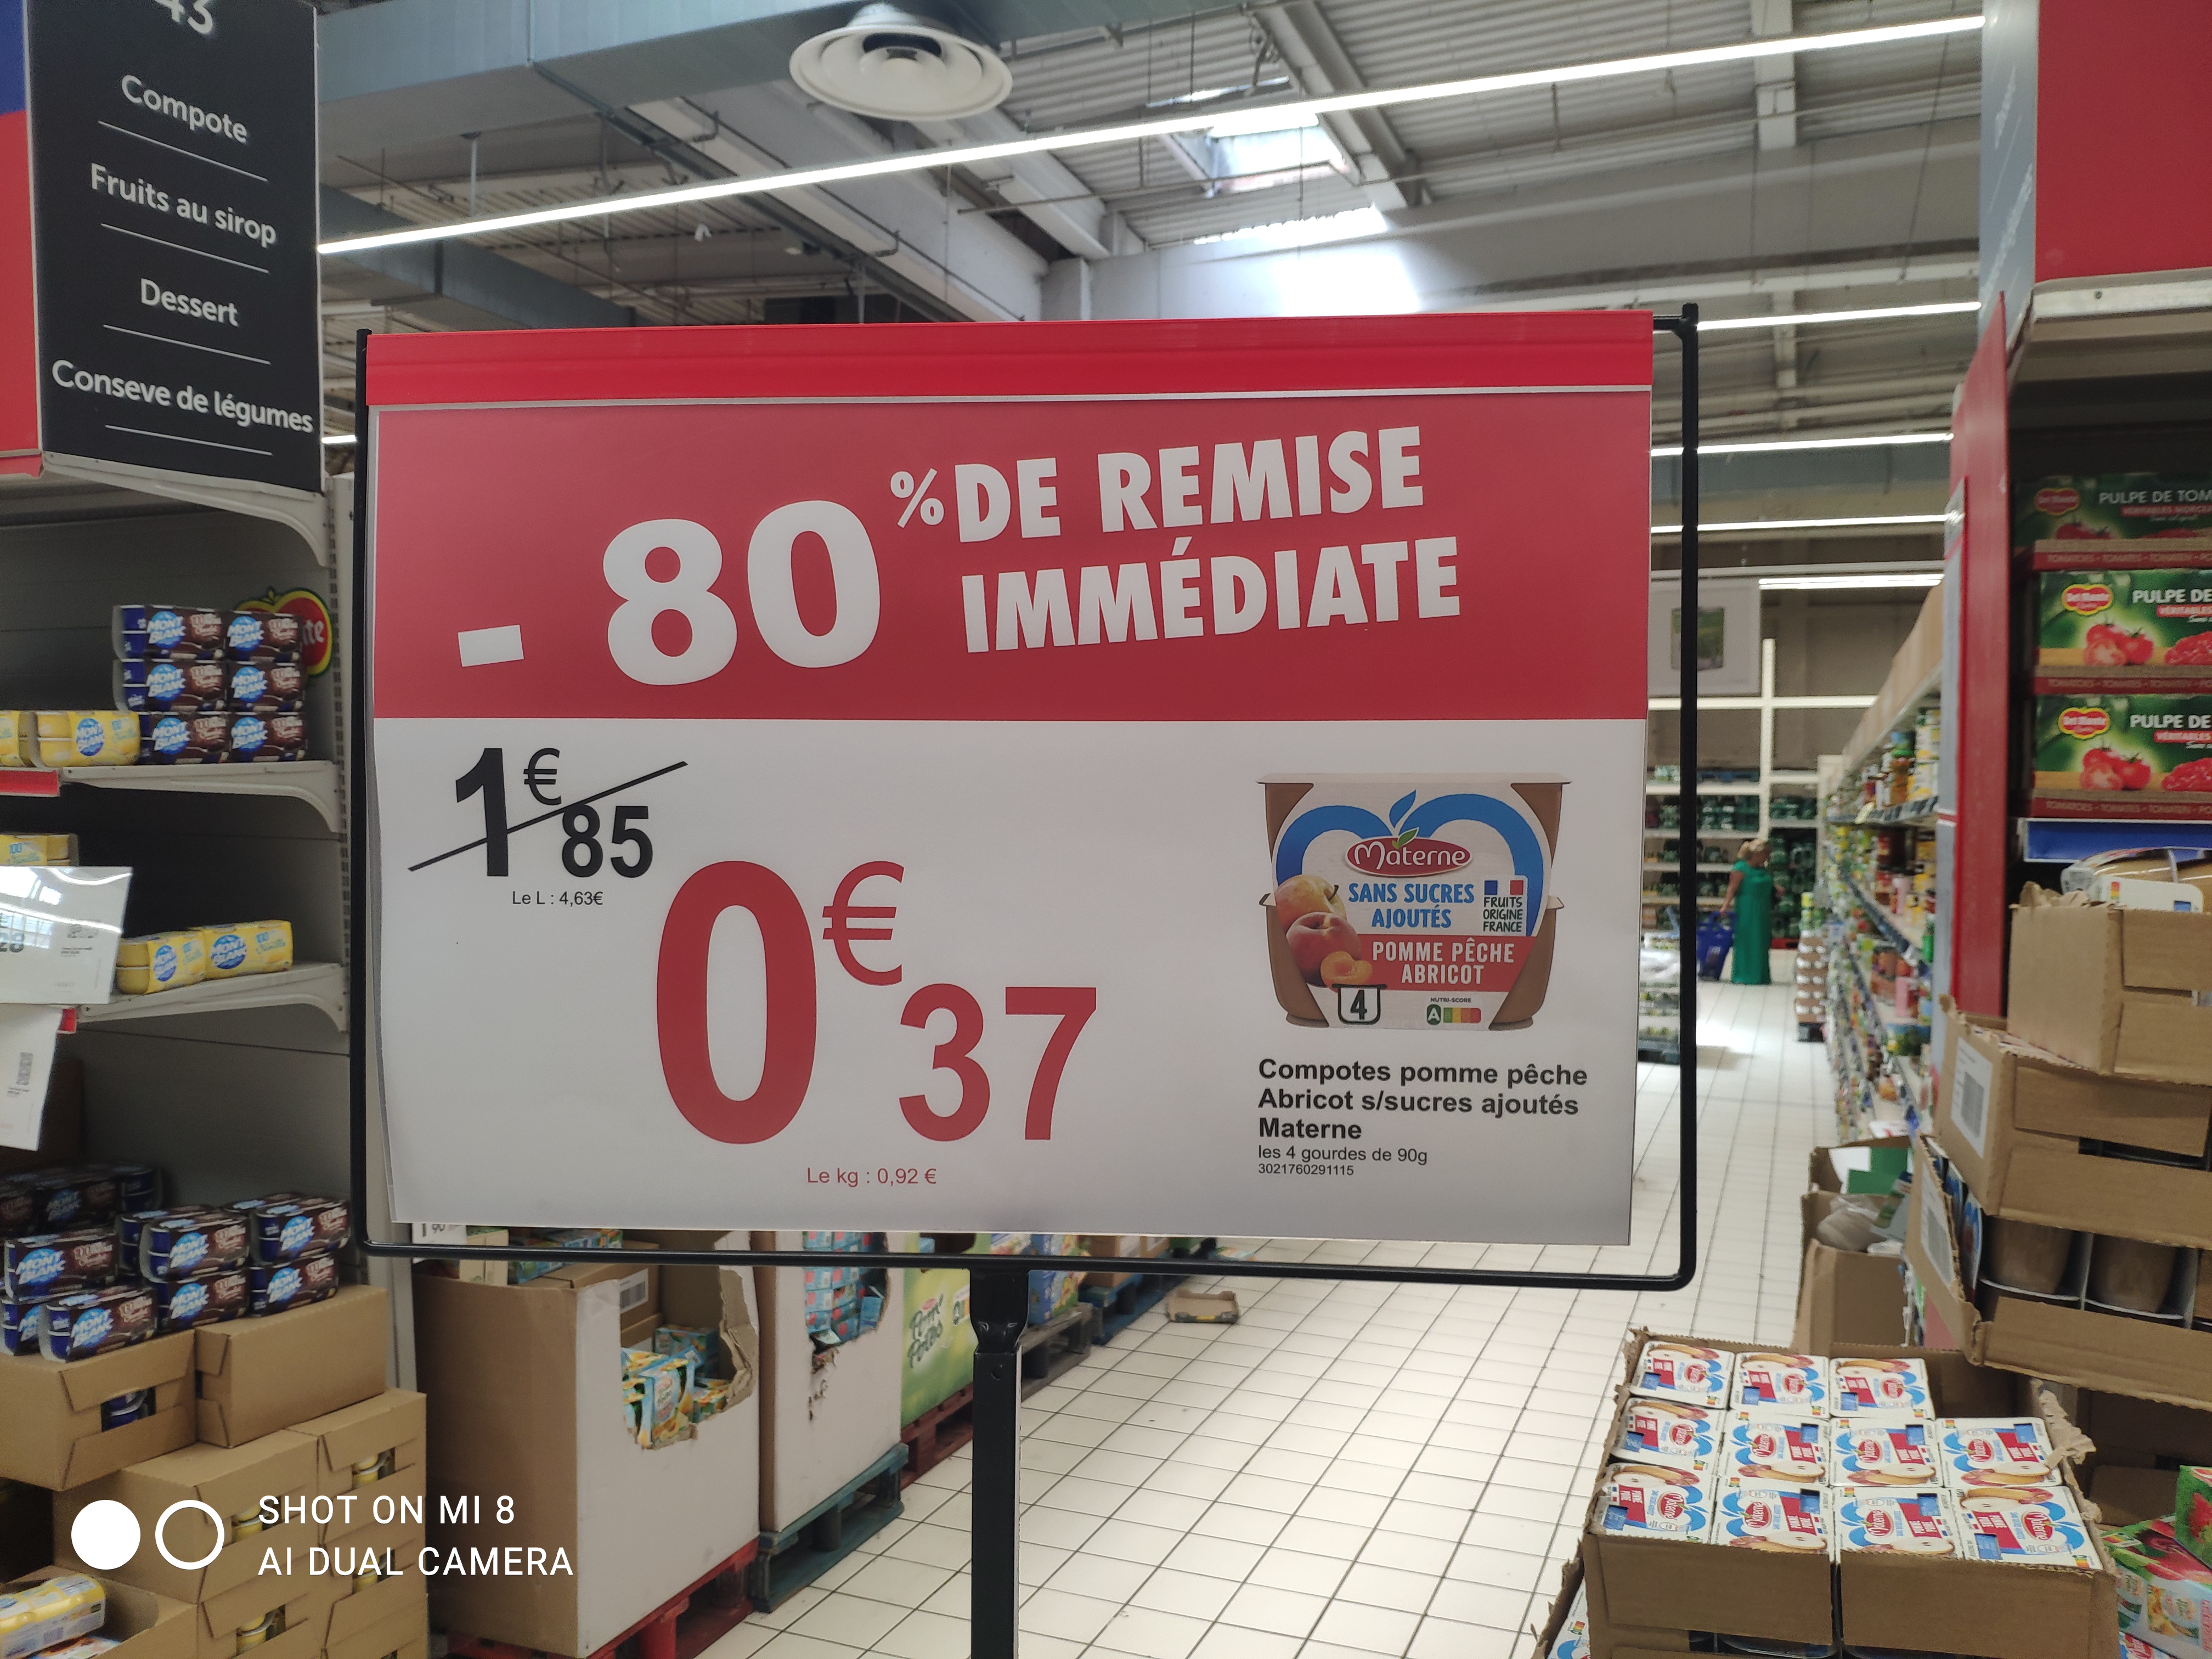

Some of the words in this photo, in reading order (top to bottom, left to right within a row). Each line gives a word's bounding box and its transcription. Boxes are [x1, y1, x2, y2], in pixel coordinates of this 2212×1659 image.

[122, 75, 247, 144] Compote
[91, 162, 170, 212] Fruits
[177, 198, 208, 224] au
[215, 207, 276, 249] sirop
[140, 278, 239, 328] Dessert
[52, 359, 171, 407] Conseve
[176, 385, 208, 414] de
[214, 391, 313, 433] légumes
[955, 458, 1061, 543] DE
[1097, 426, 1423, 533] REMISE
[2099, 491, 2147, 504] PULPE
[2152, 490, 2172, 503] DE
[603, 500, 880, 685] 80
[962, 536, 1460, 653] IMMÉDIATE
[2132, 589, 2186, 604] PULPE
[2190, 588, 2212, 603] DE
[2130, 714, 2183, 729] PULPE
[2188, 715, 2211, 729] DE
[562, 804, 653, 878] 85
[1353, 841, 1466, 870] Materne
[512, 891, 531, 905] Le
[537, 891, 546, 905] L
[559, 891, 603, 907] 4,63€
[1348, 882, 1397, 903] SANS
[1404, 883, 1475, 904] SUCRES
[1483, 896, 1523, 908] FRUITS
[1371, 904, 1452, 929] AJOUTÉS
[1482, 909, 1523, 920] ORIGINE
[1483, 921, 1522, 933] FRANCE
[1372, 941, 1443, 962] POMME
[1452, 937, 1515, 963] PÊCHE
[1401, 963, 1485, 985] ABRICOT
[657, 860, 817, 1144] 0
[822, 861, 904, 986] €
[899, 983, 1097, 1142] 37
[1350, 989, 1368, 1021] 4
[1259, 1058, 1391, 1085] Compotes
[1401, 1066, 1498, 1087] pomme
[1507, 1064, 1588, 1089] pêche
[1257, 1088, 1354, 1110] Abricot
[1361, 1090, 1472, 1113] s/sucres
[1481, 1092, 1578, 1119] ajoutés
[1259, 1117, 1362, 1139] Materne
[1259, 1144, 1281, 1159] les
[1285, 1145, 1296, 1159] 4
[1301, 1146, 1367, 1162] gourdes
[1372, 1147, 1392, 1161] de
[1397, 1148, 1427, 1165] 90g
[808, 1167, 830, 1183] Le
[837, 1167, 858, 1188] kg
[877, 1168, 918, 1187] 0,92
[924, 1168, 936, 1184] €
[1258, 1164, 1354, 1176] 3021760291115
[1667, 1492, 1684, 1519] Materne
[1746, 1501, 1764, 1528] Materne
[1869, 1509, 1883, 1536] Materne
[2027, 1512, 2048, 1540] Materne
